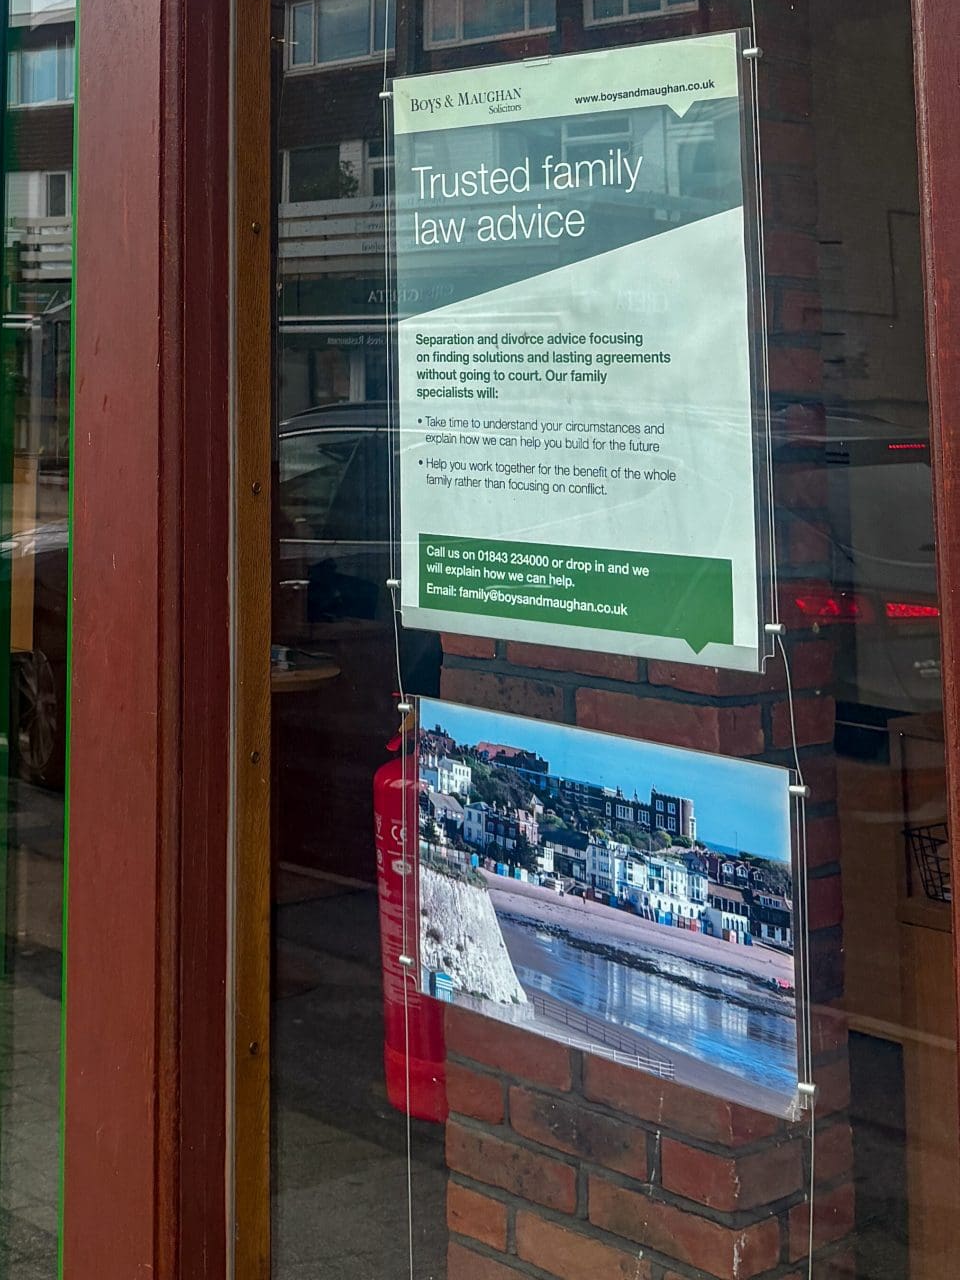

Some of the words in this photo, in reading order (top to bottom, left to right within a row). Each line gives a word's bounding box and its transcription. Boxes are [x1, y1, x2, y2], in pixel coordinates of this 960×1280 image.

[410, 97, 441, 113] BOYS
[444, 95, 454, 107] &
[458, 87, 522, 106] MAUGHAN
[575, 80, 715, 105] www.boysandmaughan.co.uk
[488, 103, 522, 115] Solicitors
[412, 157, 530, 200] Trusted
[541, 148, 643, 193] family
[414, 212, 465, 245] law
[477, 204, 585, 241] advice
[415, 333, 475, 346] Separation
[477, 333, 498, 345] and
[501, 332, 543, 345] divorce
[547, 332, 586, 345] advice
[589, 332, 643, 346] focusing
[416, 353, 430, 362] on
[433, 351, 469, 365] finding
[473, 350, 524, 363] solutions
[527, 351, 549, 363] and
[552, 350, 593, 365] lasting
[596, 350, 671, 366] agreements
[417, 369, 456, 381] without
[459, 370, 491, 383] going
[494, 370, 505, 381] to
[508, 369, 542, 381] court.
[545, 369, 568, 381] Our
[570, 369, 607, 384] family
[416, 386, 473, 400] specialists
[476, 387, 498, 398] will:
[425, 416, 446, 428] Take
[449, 417, 469, 428] time
[471, 419, 480, 429] to
[483, 418, 537, 431] understand
[540, 421, 562, 434] your
[565, 421, 641, 434] circumstances
[644, 422, 664, 435] and
[425, 432, 457, 446] explain
[459, 433, 479, 445] how
[482, 436, 496, 446] we
[499, 436, 517, 447] can
[520, 435, 541, 450] help
[543, 439, 562, 451] you
[565, 437, 589, 449] build
[592, 437, 606, 450] for
[609, 438, 626, 451] the
[629, 439, 660, 452] future
[426, 457, 447, 473] Help
[450, 461, 466, 473] you
[469, 460, 493, 472] work
[495, 461, 536, 476] together
[538, 462, 552, 475] for
[554, 464, 570, 475] the
[573, 464, 608, 477] benefit
[611, 466, 621, 478] of
[624, 467, 641, 479] the
[643, 468, 676, 481] whole
[426, 475, 452, 488] family
[454, 475, 481, 488] rather
[484, 477, 505, 489] than
[508, 478, 550, 493] focusing
[552, 483, 566, 492] on
[568, 481, 607, 495] conflict.
[427, 545, 445, 558] Call
[448, 549, 459, 559] us
[462, 549, 475, 560] on
[477, 549, 508, 563] 01843
[510, 551, 549, 567] 234000
[552, 556, 563, 568] or
[566, 556, 592, 573] drop
[595, 560, 605, 572] in
[608, 560, 629, 575] and
[632, 566, 649, 576] we
[427, 562, 442, 574] will
[445, 564, 481, 580] explain
[483, 567, 505, 580] how
[508, 571, 523, 581] we
[526, 572, 546, 584] can
[549, 572, 575, 588] help.
[427, 582, 456, 597] Email:
[459, 586, 628, 616] family@boysandmaughan.co.uk
